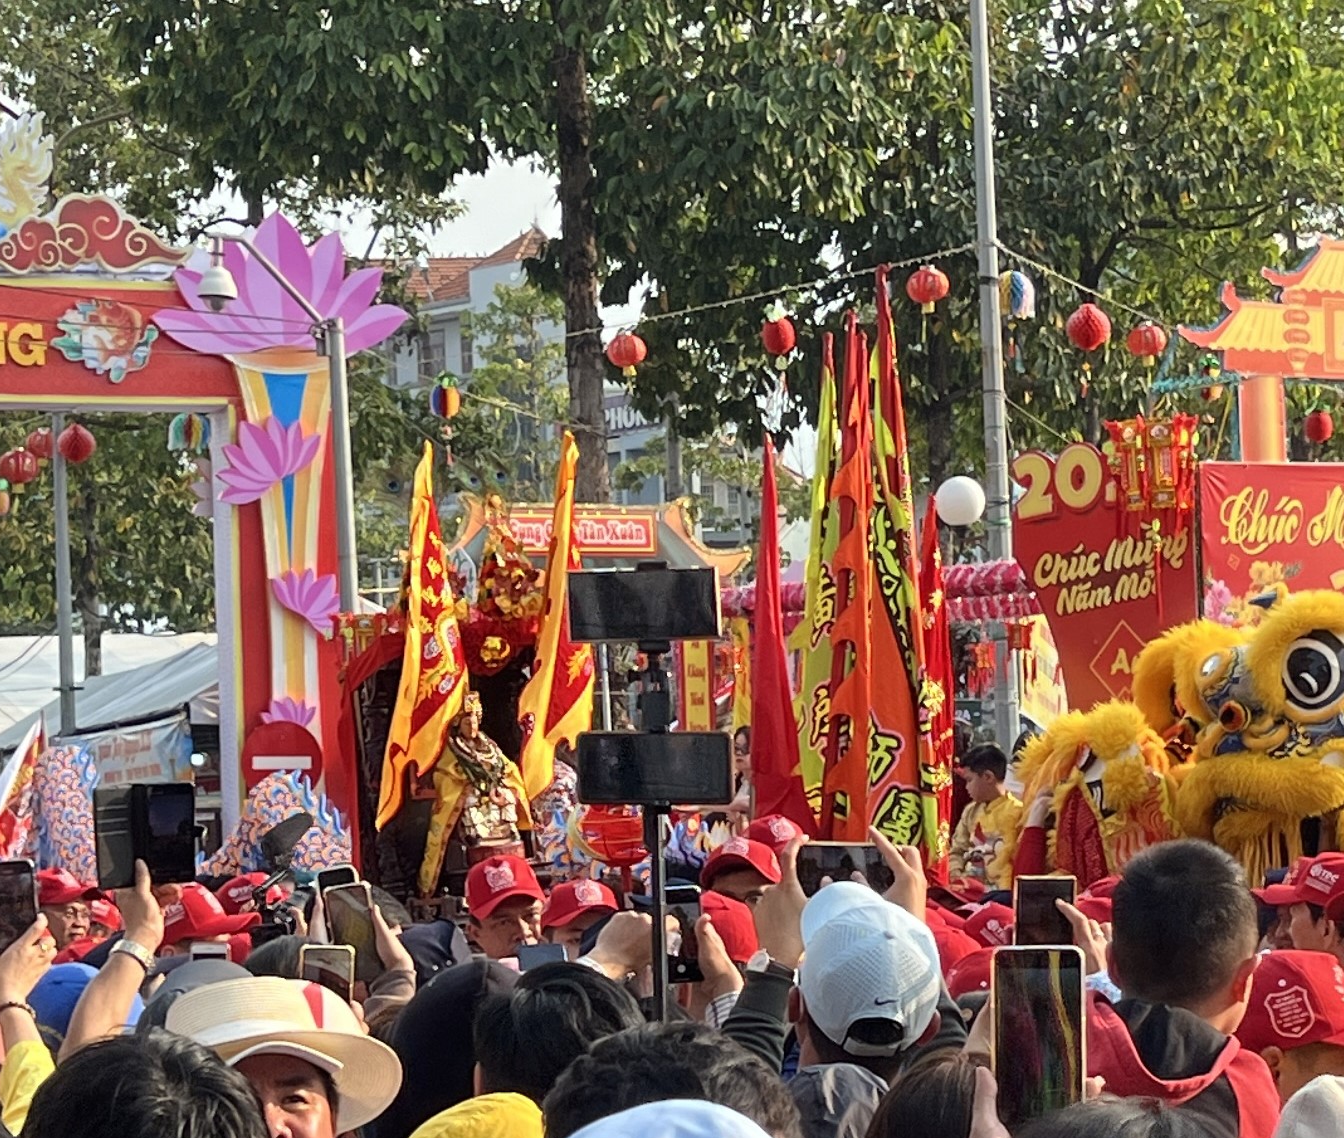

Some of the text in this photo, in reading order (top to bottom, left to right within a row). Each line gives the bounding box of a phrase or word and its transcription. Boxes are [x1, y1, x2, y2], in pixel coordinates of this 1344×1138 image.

[1220, 486, 1304, 555] Chúc
[1034, 543, 1102, 588] Chúc
[1057, 581, 1112, 616] Năm
